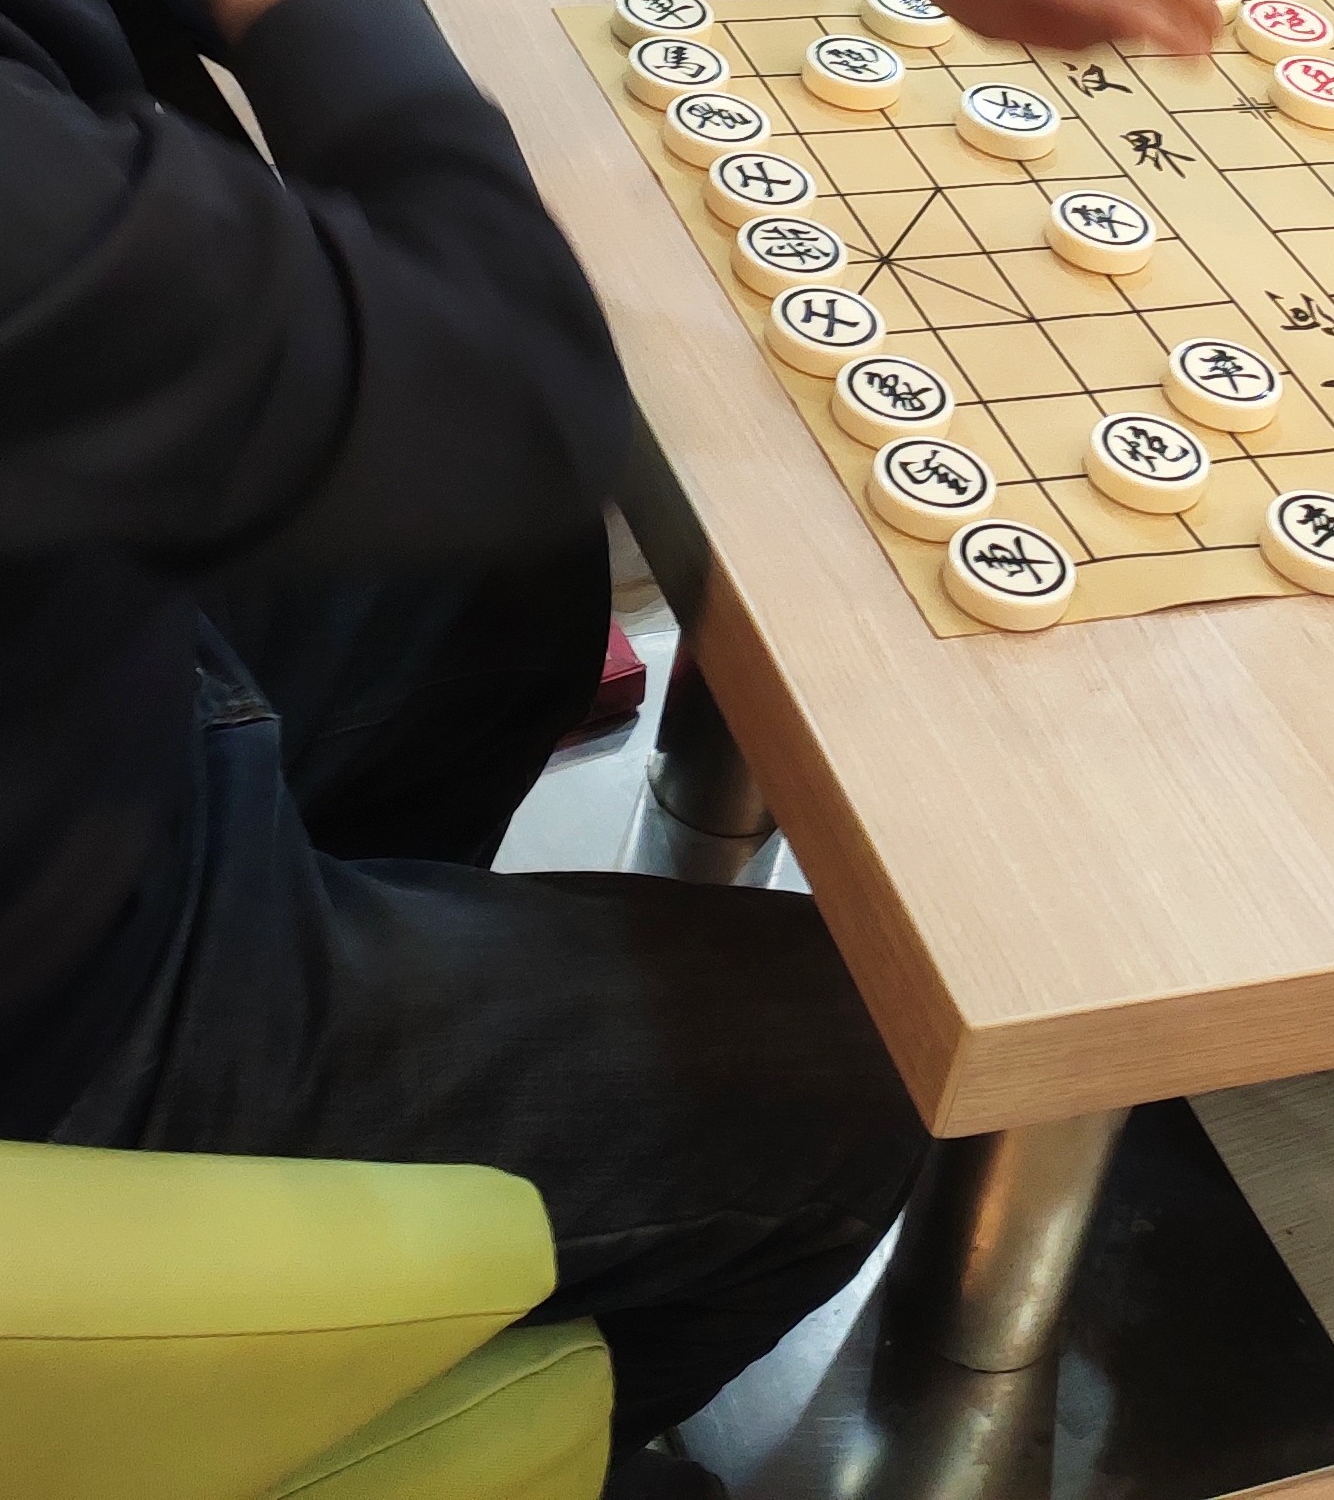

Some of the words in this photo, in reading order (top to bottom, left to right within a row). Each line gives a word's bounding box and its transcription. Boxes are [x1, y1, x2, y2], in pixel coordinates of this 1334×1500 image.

[654, 46, 706, 79] 馬
[729, 164, 791, 197] 士
[803, 299, 859, 336] 士
[1113, 426, 1188, 473] 炮
[899, 449, 971, 497] 馬
[973, 536, 1052, 584] 車
